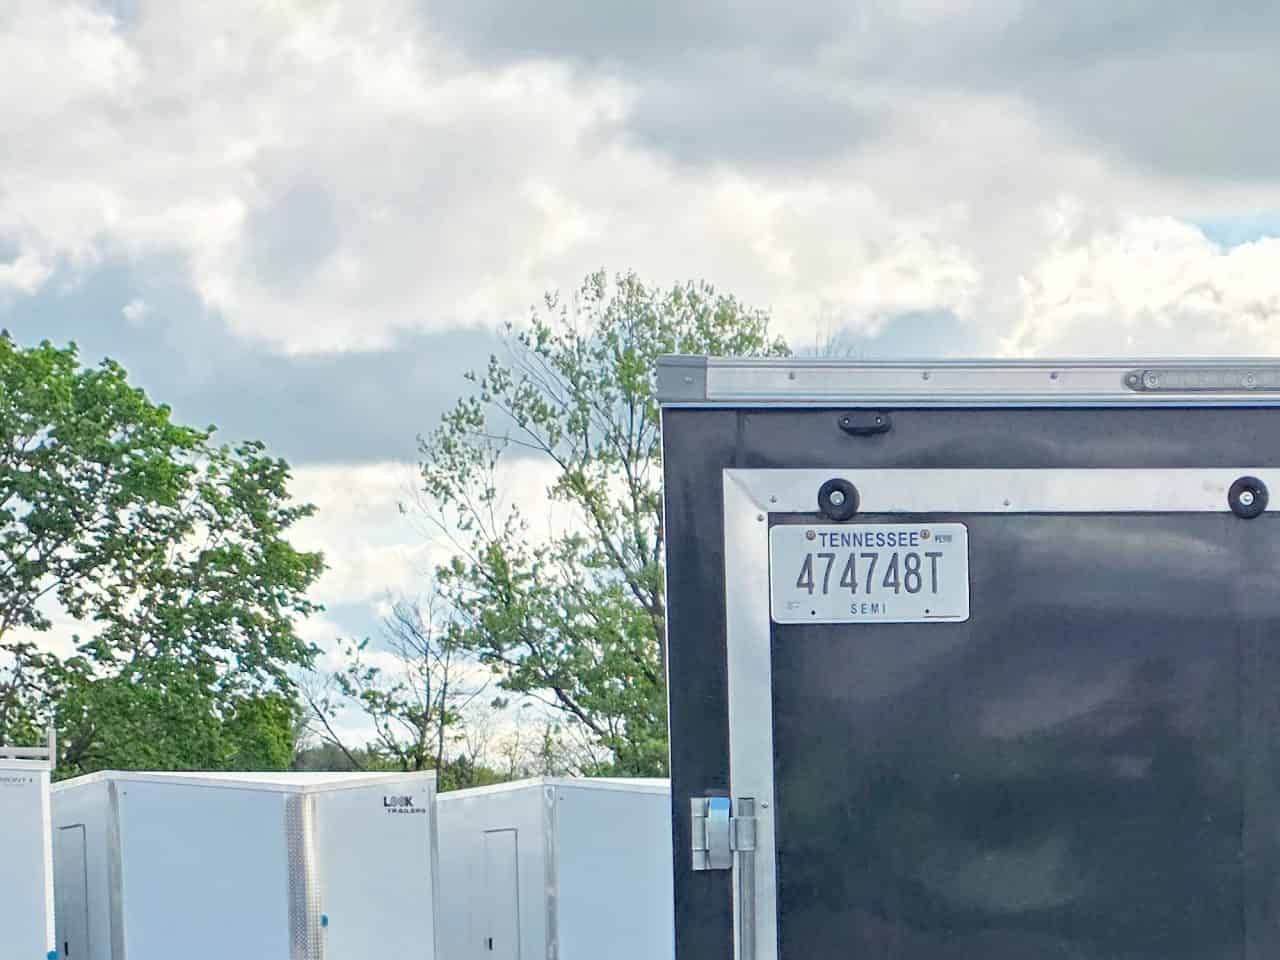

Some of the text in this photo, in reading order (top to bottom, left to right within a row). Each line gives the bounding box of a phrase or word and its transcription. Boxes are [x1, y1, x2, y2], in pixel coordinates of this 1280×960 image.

[818, 532, 919, 548] TENNESSEE
[796, 552, 943, 595] 474748T
[850, 603, 886, 615] SEMI
